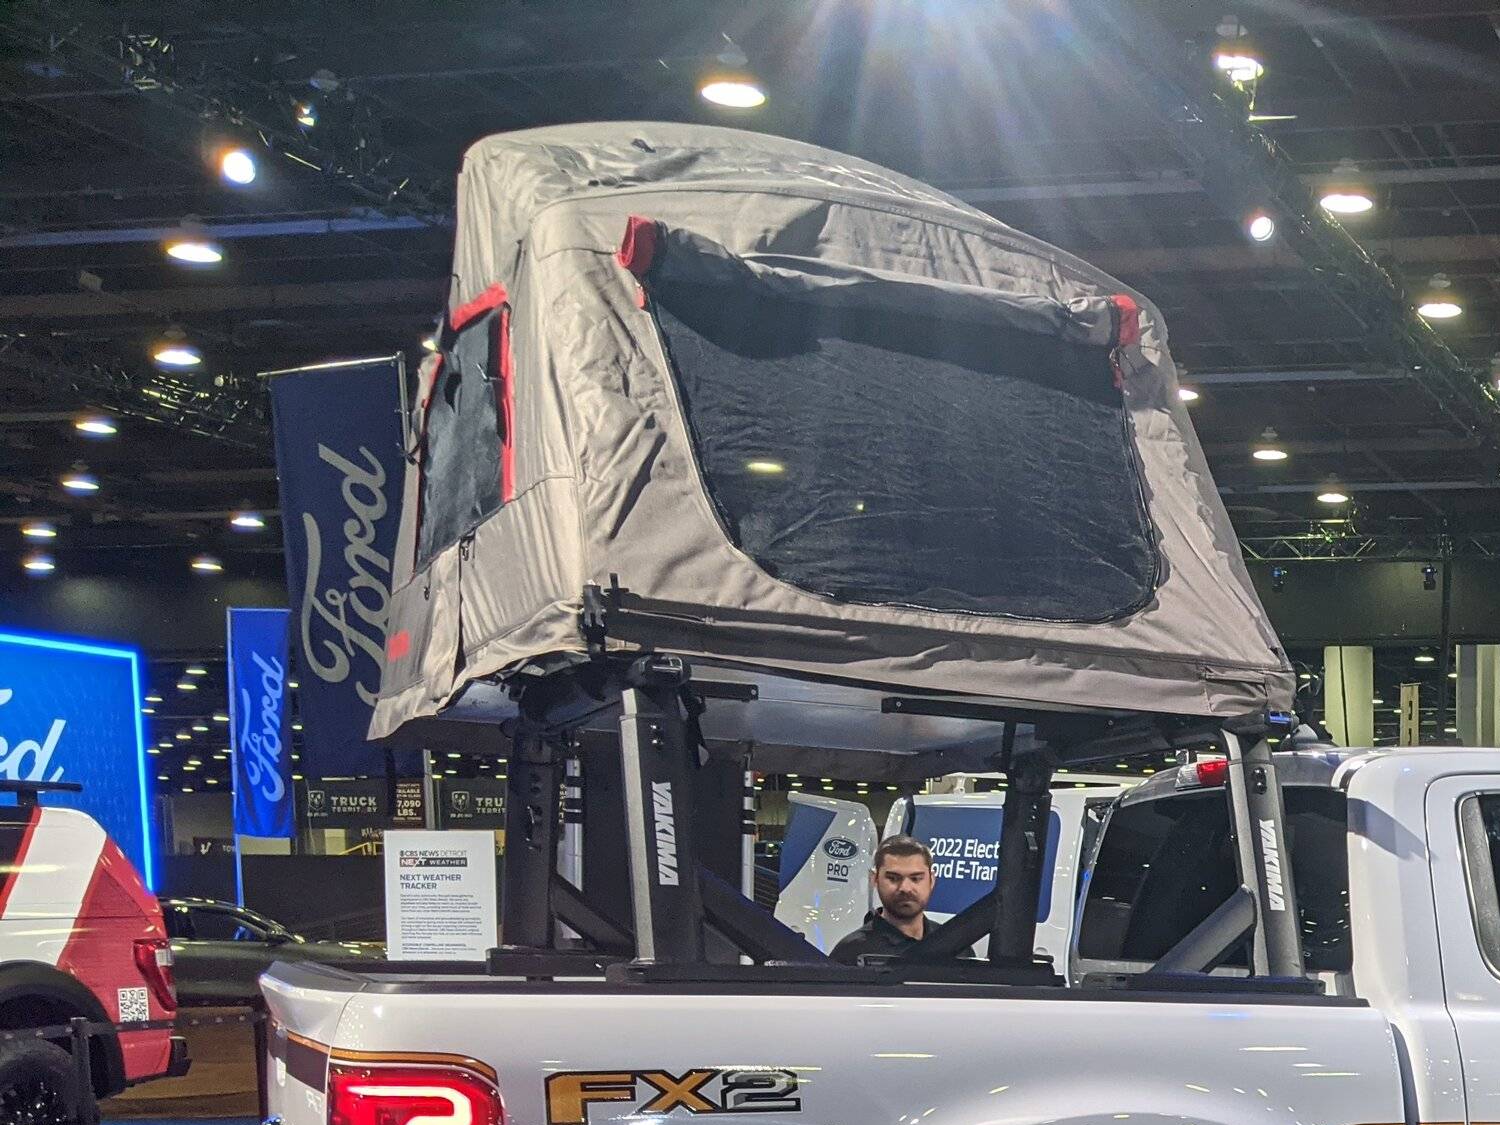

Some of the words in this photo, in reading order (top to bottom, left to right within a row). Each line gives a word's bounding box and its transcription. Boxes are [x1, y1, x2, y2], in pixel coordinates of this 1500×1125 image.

[303, 443, 390, 706] Ford
[241, 651, 285, 802] Ford
[330, 796, 377, 806] TRUCK
[475, 797, 503, 807] TRU
[397, 808, 417, 816] LBS.
[652, 781, 680, 886] YAKIMA
[828, 840, 851, 858] Ford
[929, 838, 963, 858] 2022
[964, 839, 1000, 859] Elect
[400, 857, 427, 868] NEXT
[827, 863, 849, 876] PRO
[1258, 818, 1286, 912] YAKIMA
[400, 873, 421, 881] NEXT
[422, 873, 462, 881] WEATHER
[931, 860, 954, 878] ord
[955, 860, 998, 881] E-Tran
[400, 882, 437, 890] TRACKER
